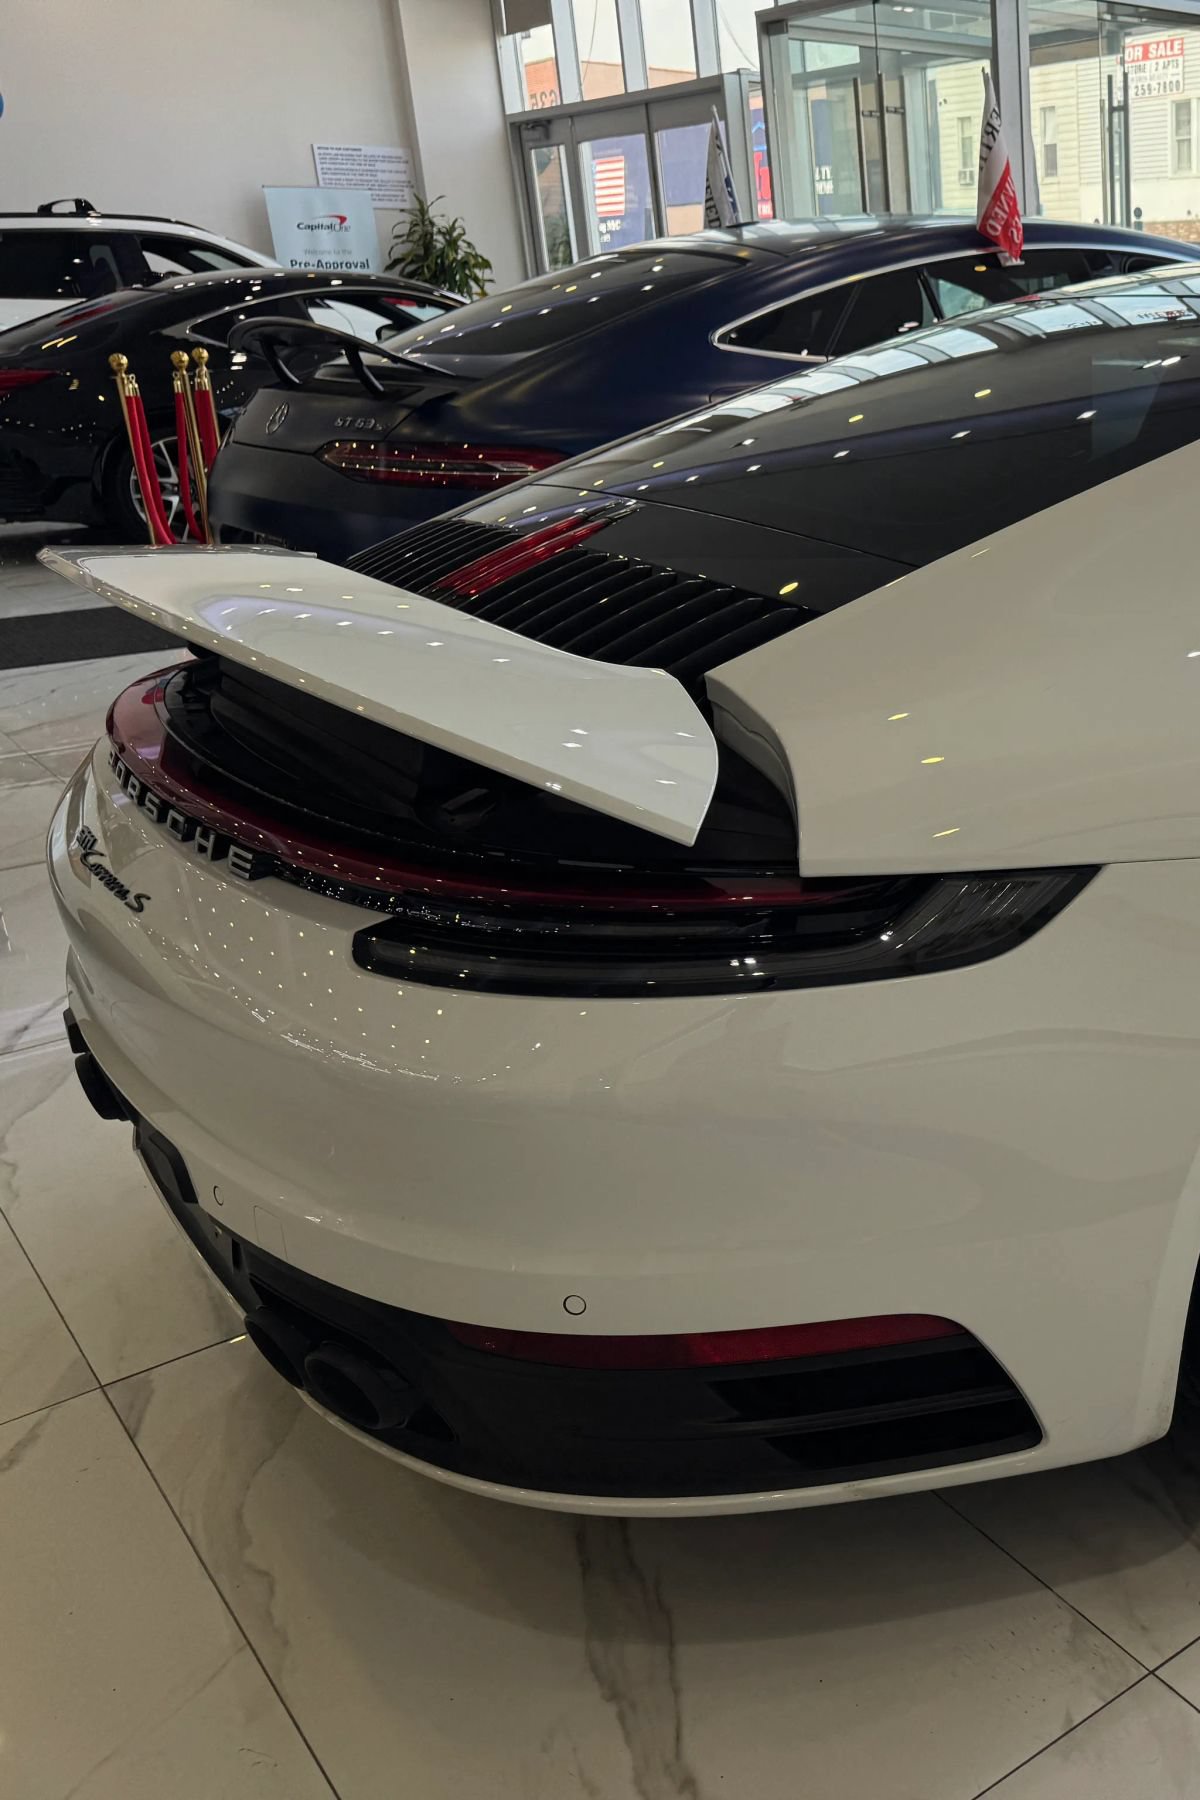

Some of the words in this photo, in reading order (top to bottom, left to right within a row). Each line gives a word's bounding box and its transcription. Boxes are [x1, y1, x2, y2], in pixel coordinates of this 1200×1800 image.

[1125, 45, 1143, 62] OR
[1148, 40, 1182, 59] SALE
[290, 258, 370, 270] Pre-Approval
[124, 893, 151, 913] S
